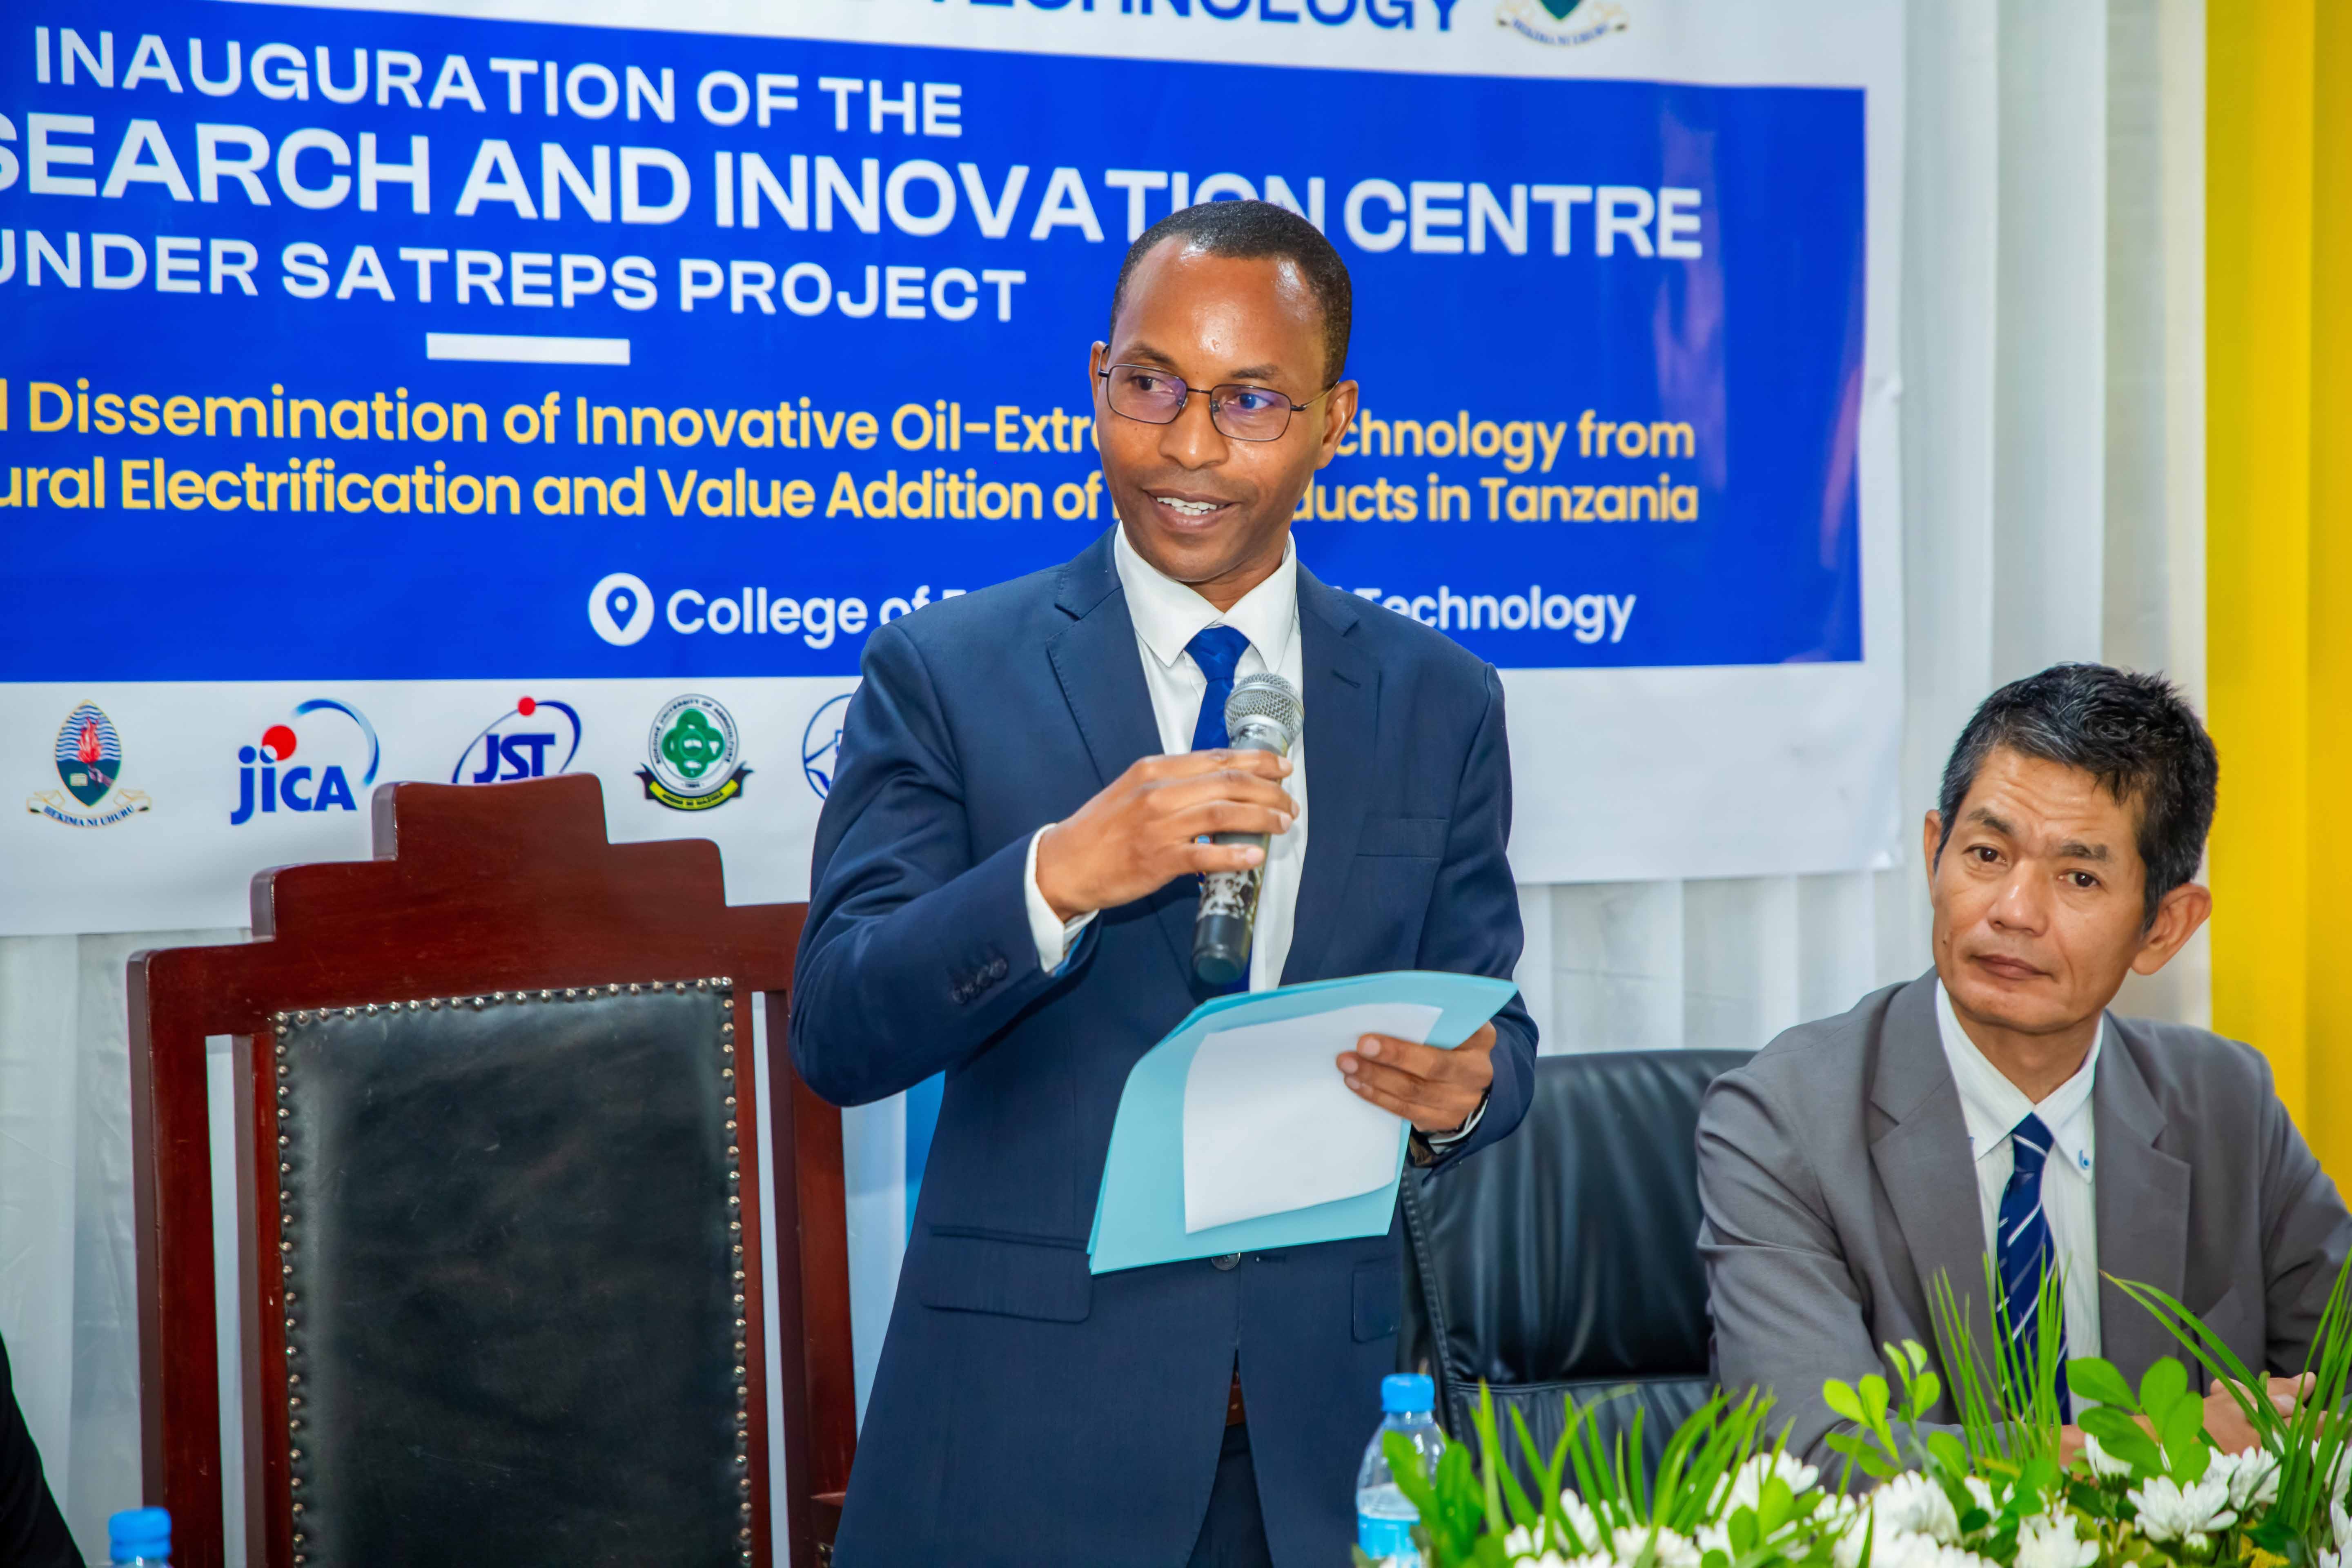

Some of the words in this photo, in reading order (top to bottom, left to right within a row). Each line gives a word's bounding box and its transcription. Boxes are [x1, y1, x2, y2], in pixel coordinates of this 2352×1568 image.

[37, 28, 675, 122] INAUGURATION
[698, 71, 798, 127] OF
[819, 78, 962, 137] THE
[0, 114, 430, 214] EARCH
[456, 140, 690, 224] AND
[1345, 180, 1702, 260] CENTRE
[283, 243, 657, 310] SATREPS
[680, 259, 1026, 321] PROJECT
[31, 378, 487, 442] Dissemination
[504, 392, 560, 443] of
[577, 397, 878, 449] Innovative
[892, 400, 1100, 452] Oil-Extr
[1577, 410, 1695, 457] from
[122, 458, 520, 514] Electrification
[534, 466, 645, 516] and
[658, 468, 815, 517] Value
[826, 468, 1042, 519] Addition
[1053, 470, 1102, 519] of
[1428, 473, 1470, 521] in
[1480, 473, 1698, 521] Tanzania
[668, 588, 868, 649] College
[474, 733, 556, 783] JST
